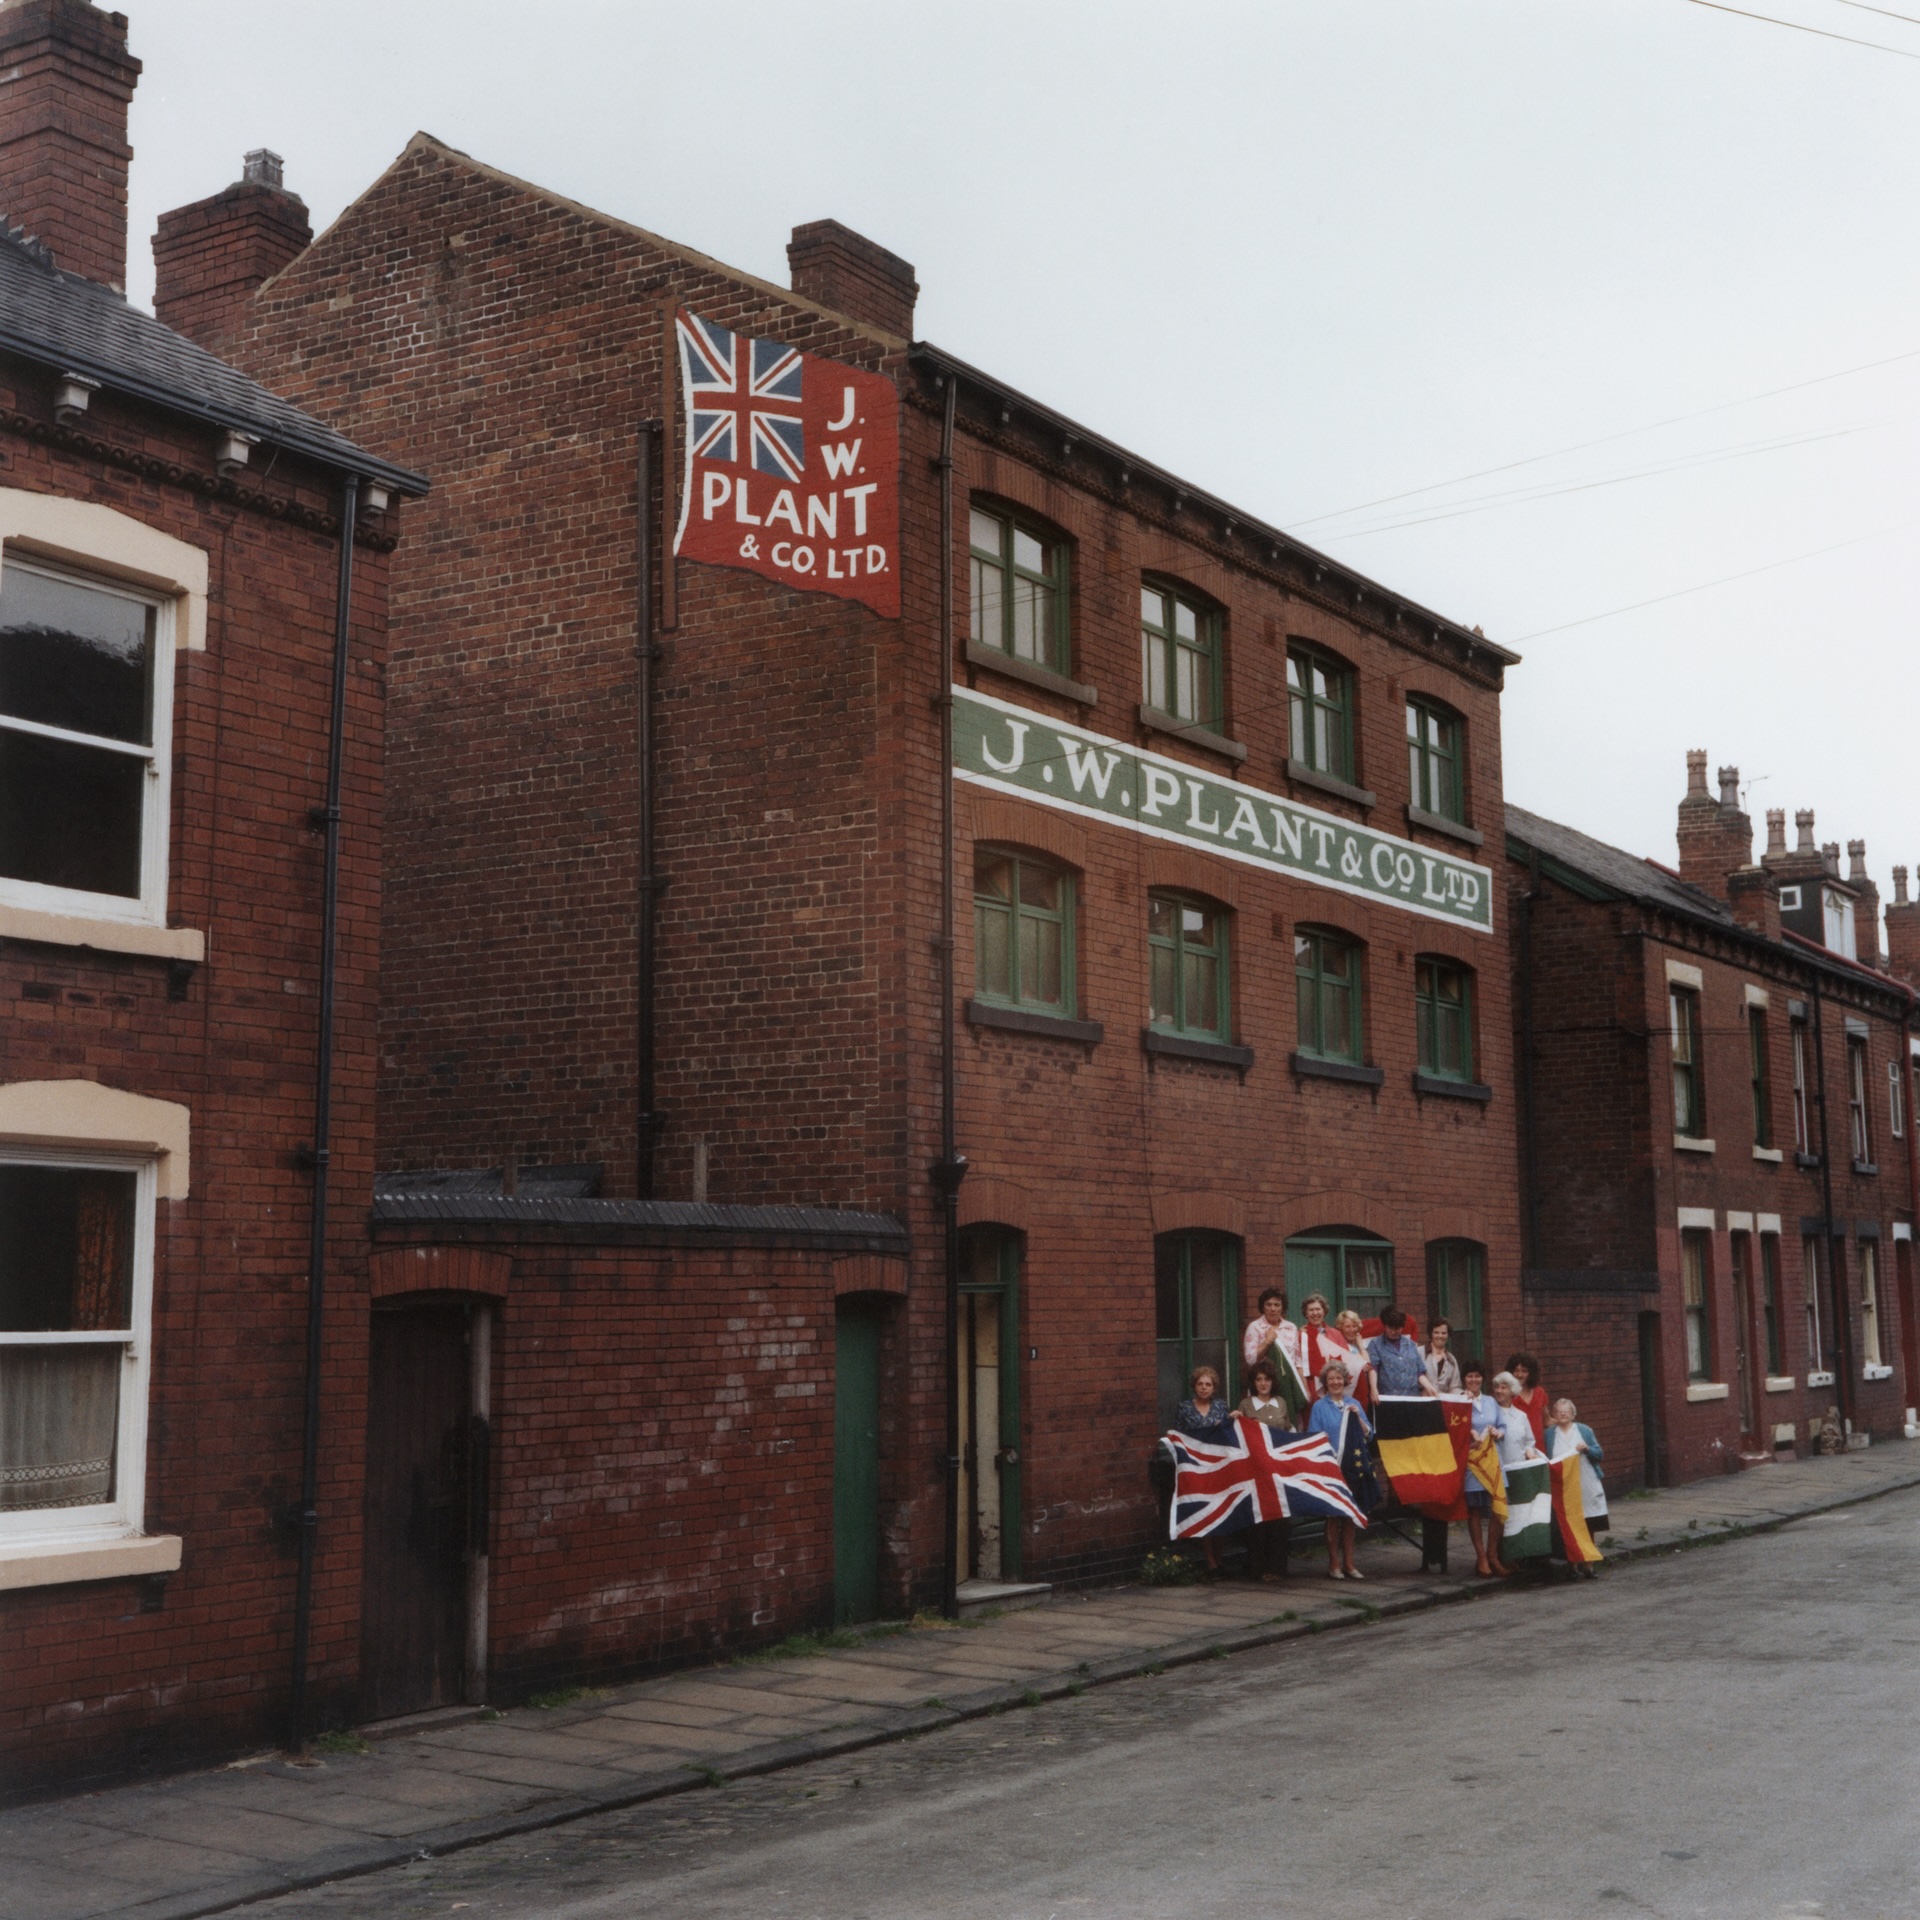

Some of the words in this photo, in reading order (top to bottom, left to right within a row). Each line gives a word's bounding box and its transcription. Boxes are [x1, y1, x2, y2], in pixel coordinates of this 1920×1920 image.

[827, 386, 865, 432] J.
[820, 438, 866, 481] W.
[702, 471, 878, 540] PLANT
[739, 533, 761, 561] &
[771, 542, 817, 576] CO.
[827, 544, 890, 579] LTD.
[1141, 763, 1336, 869] PLANT
[1340, 836, 1364, 879] &
